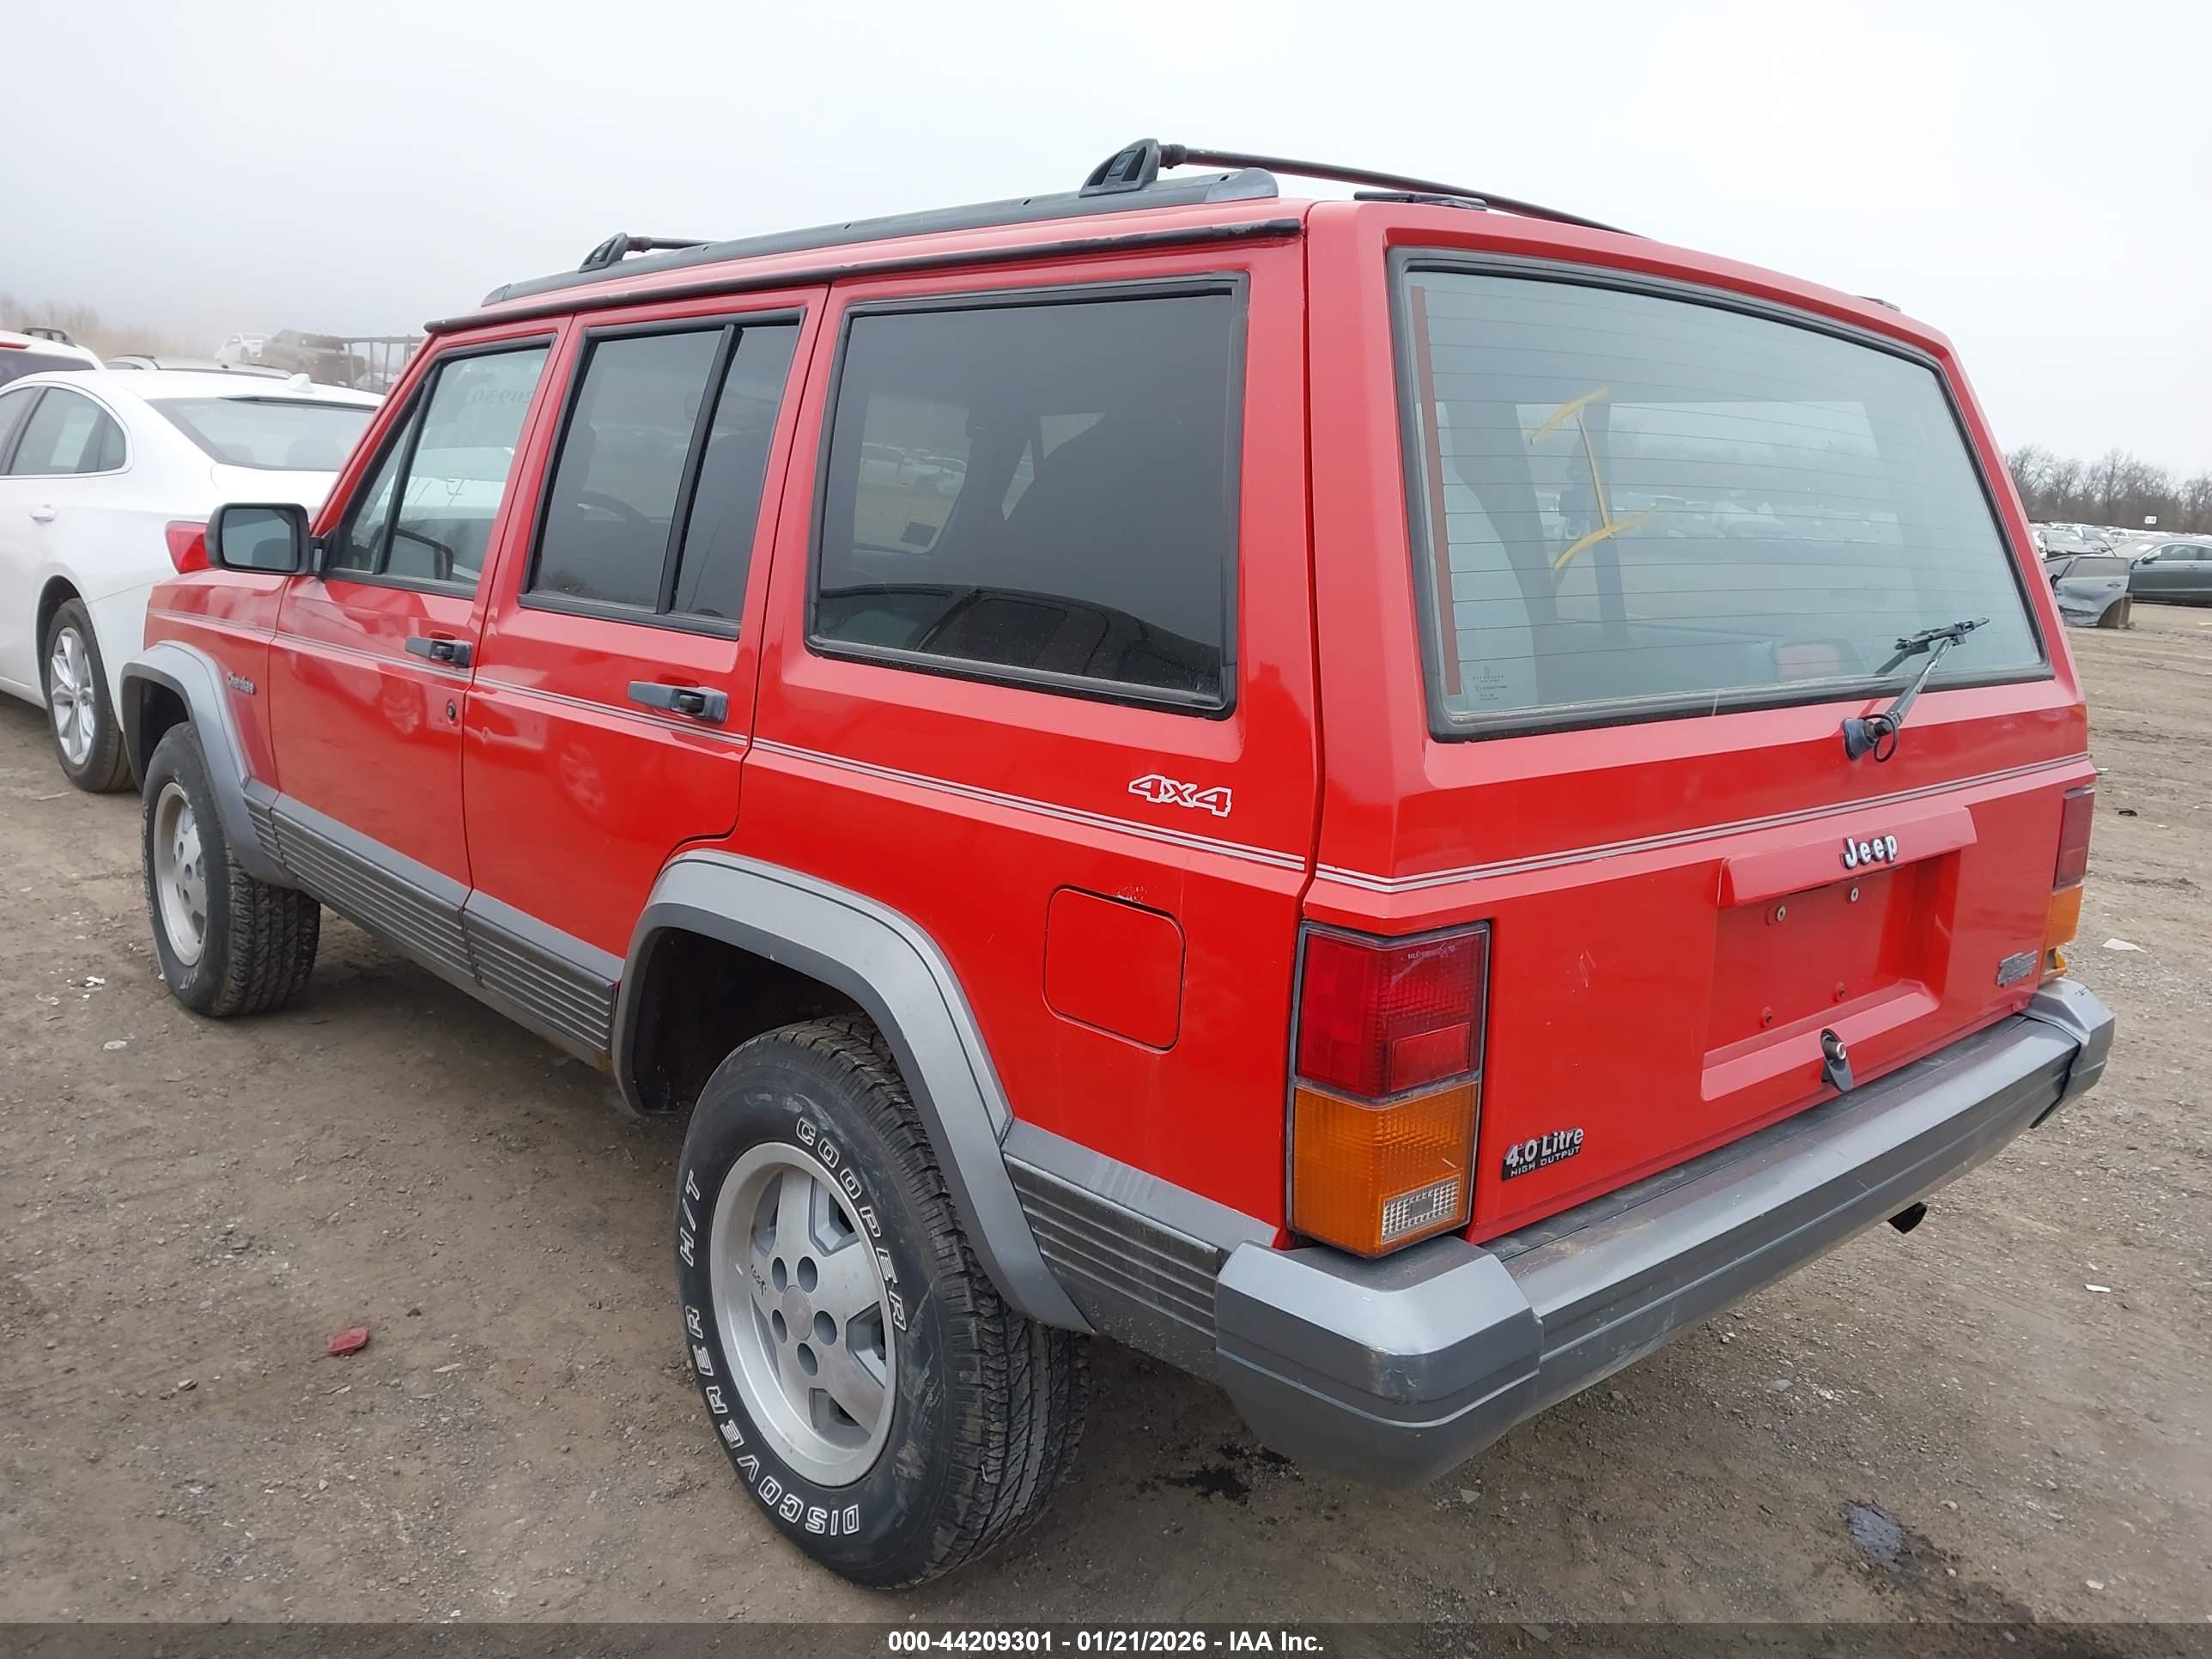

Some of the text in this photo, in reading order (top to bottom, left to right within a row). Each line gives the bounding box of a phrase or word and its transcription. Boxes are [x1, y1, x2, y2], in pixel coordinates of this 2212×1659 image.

[1843, 835, 1898, 869] Jeep
[1505, 1127, 1584, 1169] 4.0 Litre
[1510, 1146, 1581, 1177] HIGH OUTPUT
[795, 1117, 908, 1333] COOPER
[679, 1170, 861, 1539] DISCOVERER H/T
